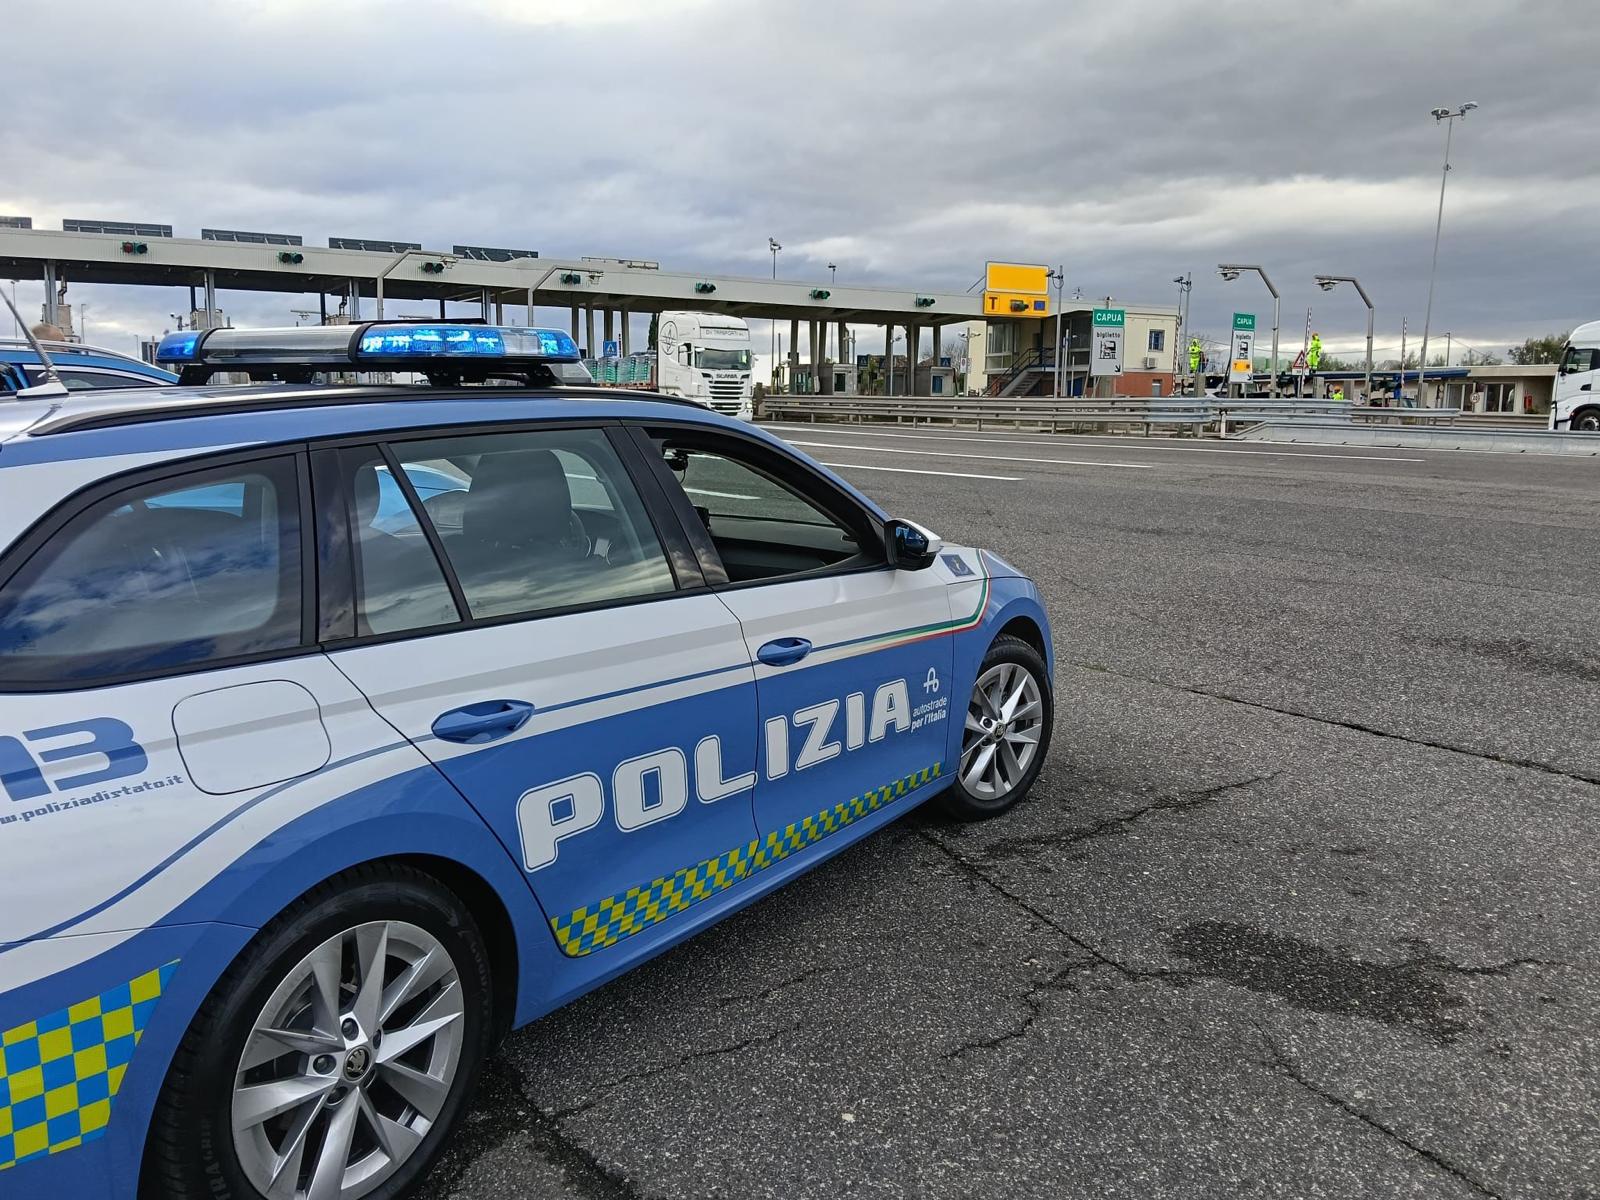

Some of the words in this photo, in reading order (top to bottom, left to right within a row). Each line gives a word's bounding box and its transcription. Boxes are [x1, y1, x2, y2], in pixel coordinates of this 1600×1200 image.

[988, 296, 998, 310] T
[1096, 313, 1122, 322] CAPUA
[1236, 317, 1253, 325] CAPUA
[912, 697, 947, 717] autostrade
[911, 717, 924, 733] per
[924, 709, 946, 725] l'Italia
[516, 678, 912, 873] POLIZIA
